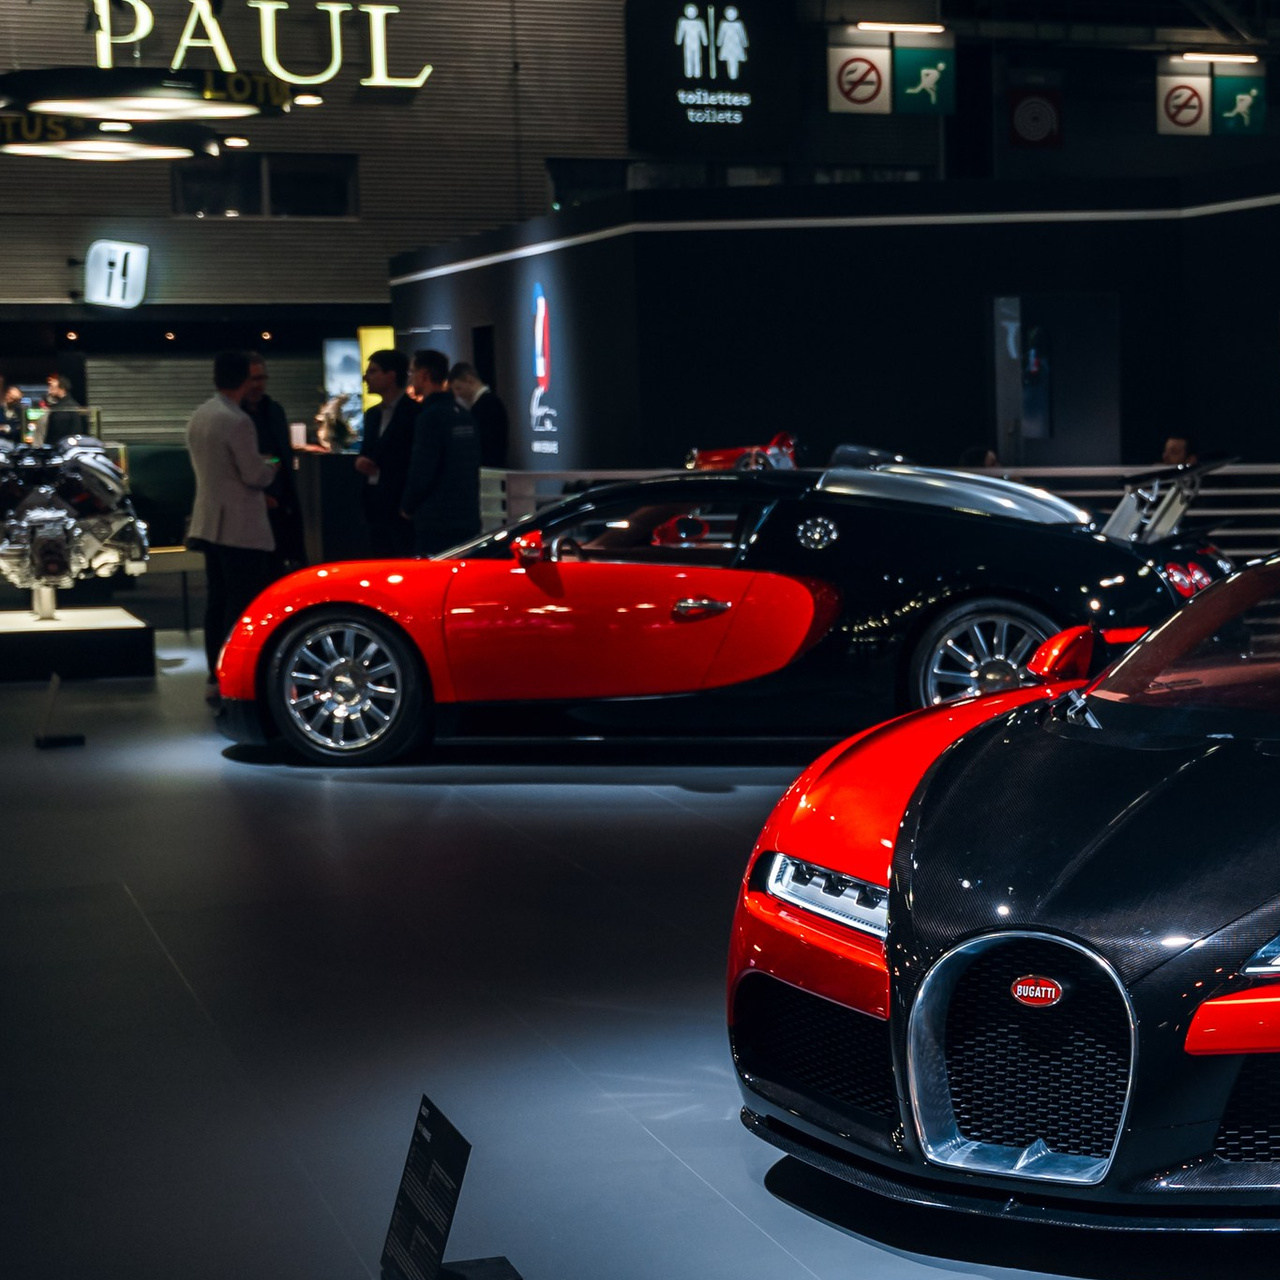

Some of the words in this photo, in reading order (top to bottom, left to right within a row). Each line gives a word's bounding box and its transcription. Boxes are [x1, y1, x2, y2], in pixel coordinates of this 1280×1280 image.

[676, 88, 751, 106] toilettes
[687, 107, 743, 124] toilets
[1016, 985, 1056, 999] BUGATTI
